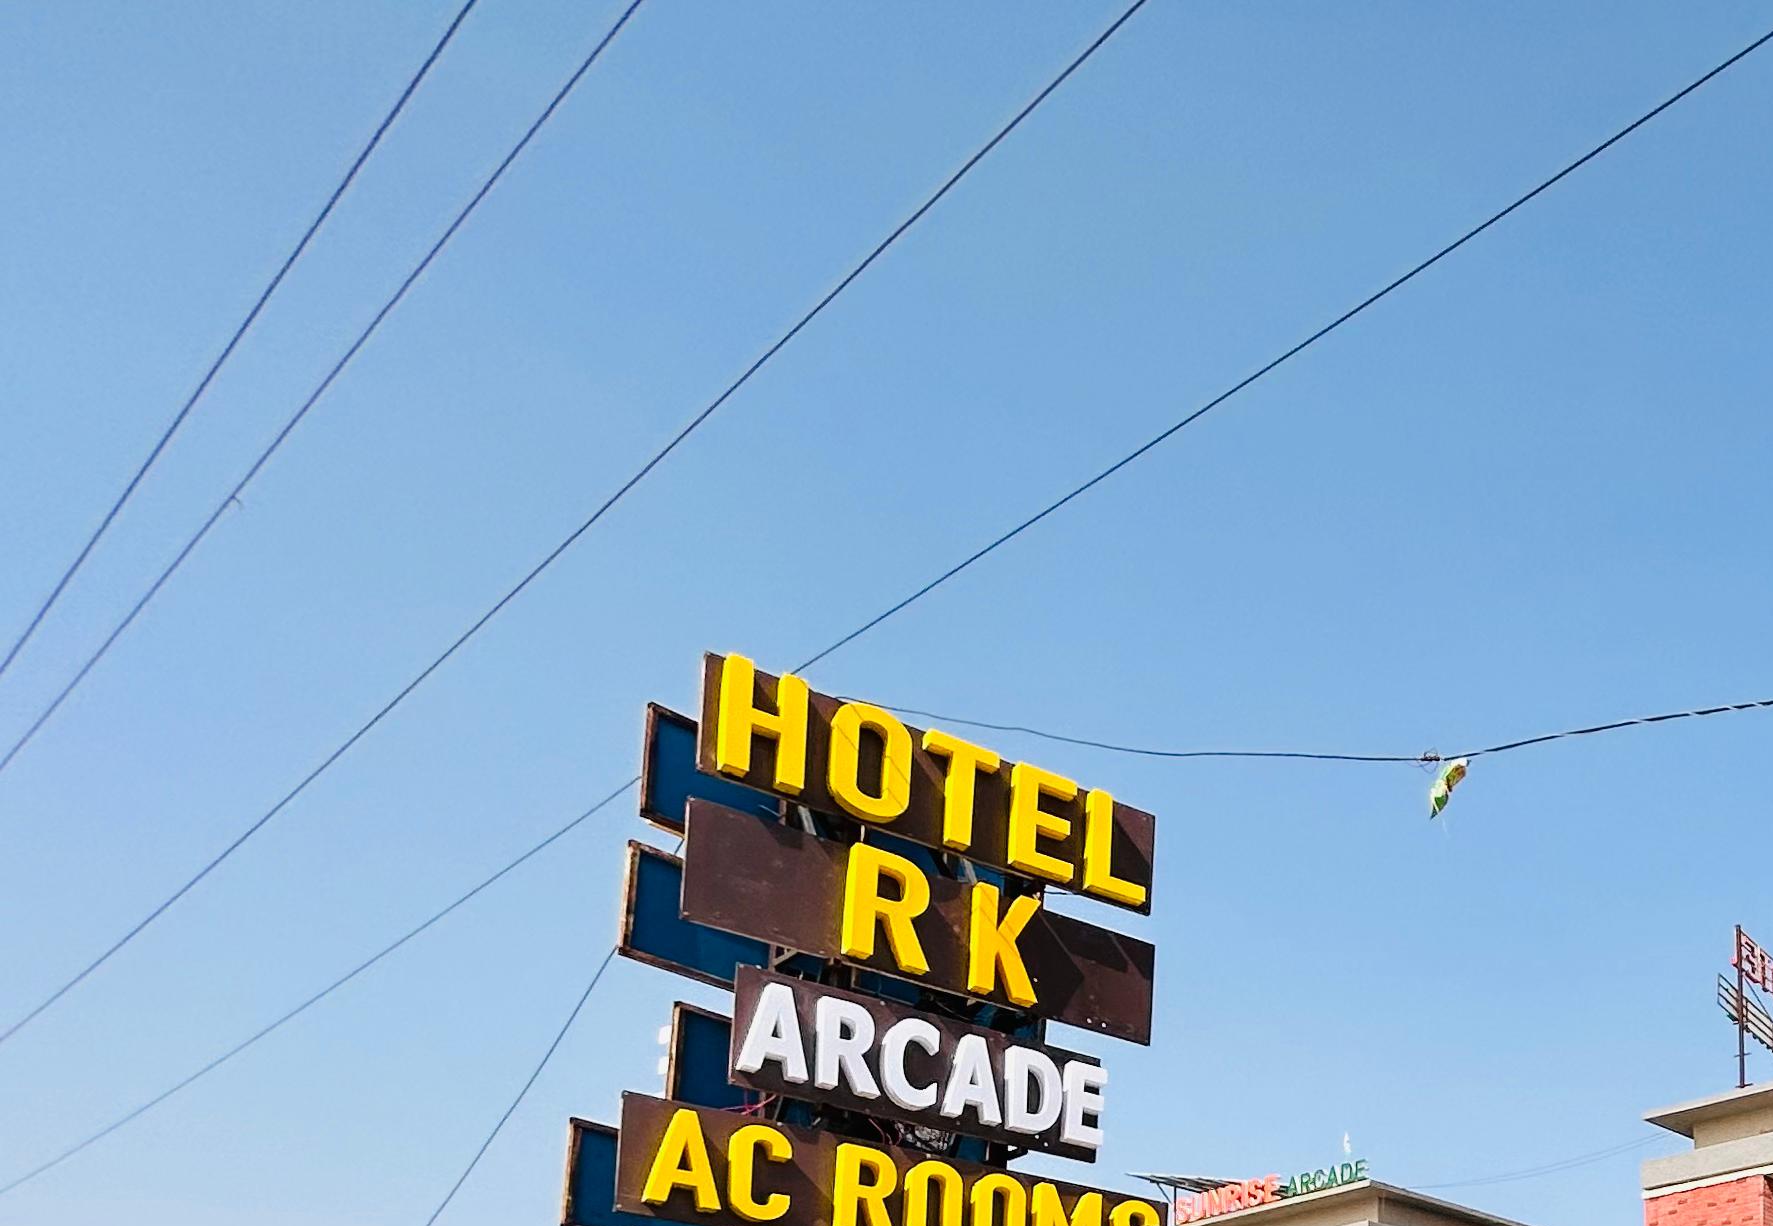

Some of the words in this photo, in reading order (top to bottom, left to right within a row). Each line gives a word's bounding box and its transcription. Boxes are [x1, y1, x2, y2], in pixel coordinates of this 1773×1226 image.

[717, 652, 1147, 907] HOTEL
[735, 981, 1109, 1150] ARCADE
[641, 1108, 794, 1223] AC
[1175, 1174, 1282, 1224] SUNRISE
[1285, 1158, 1369, 1198] ARCADE
